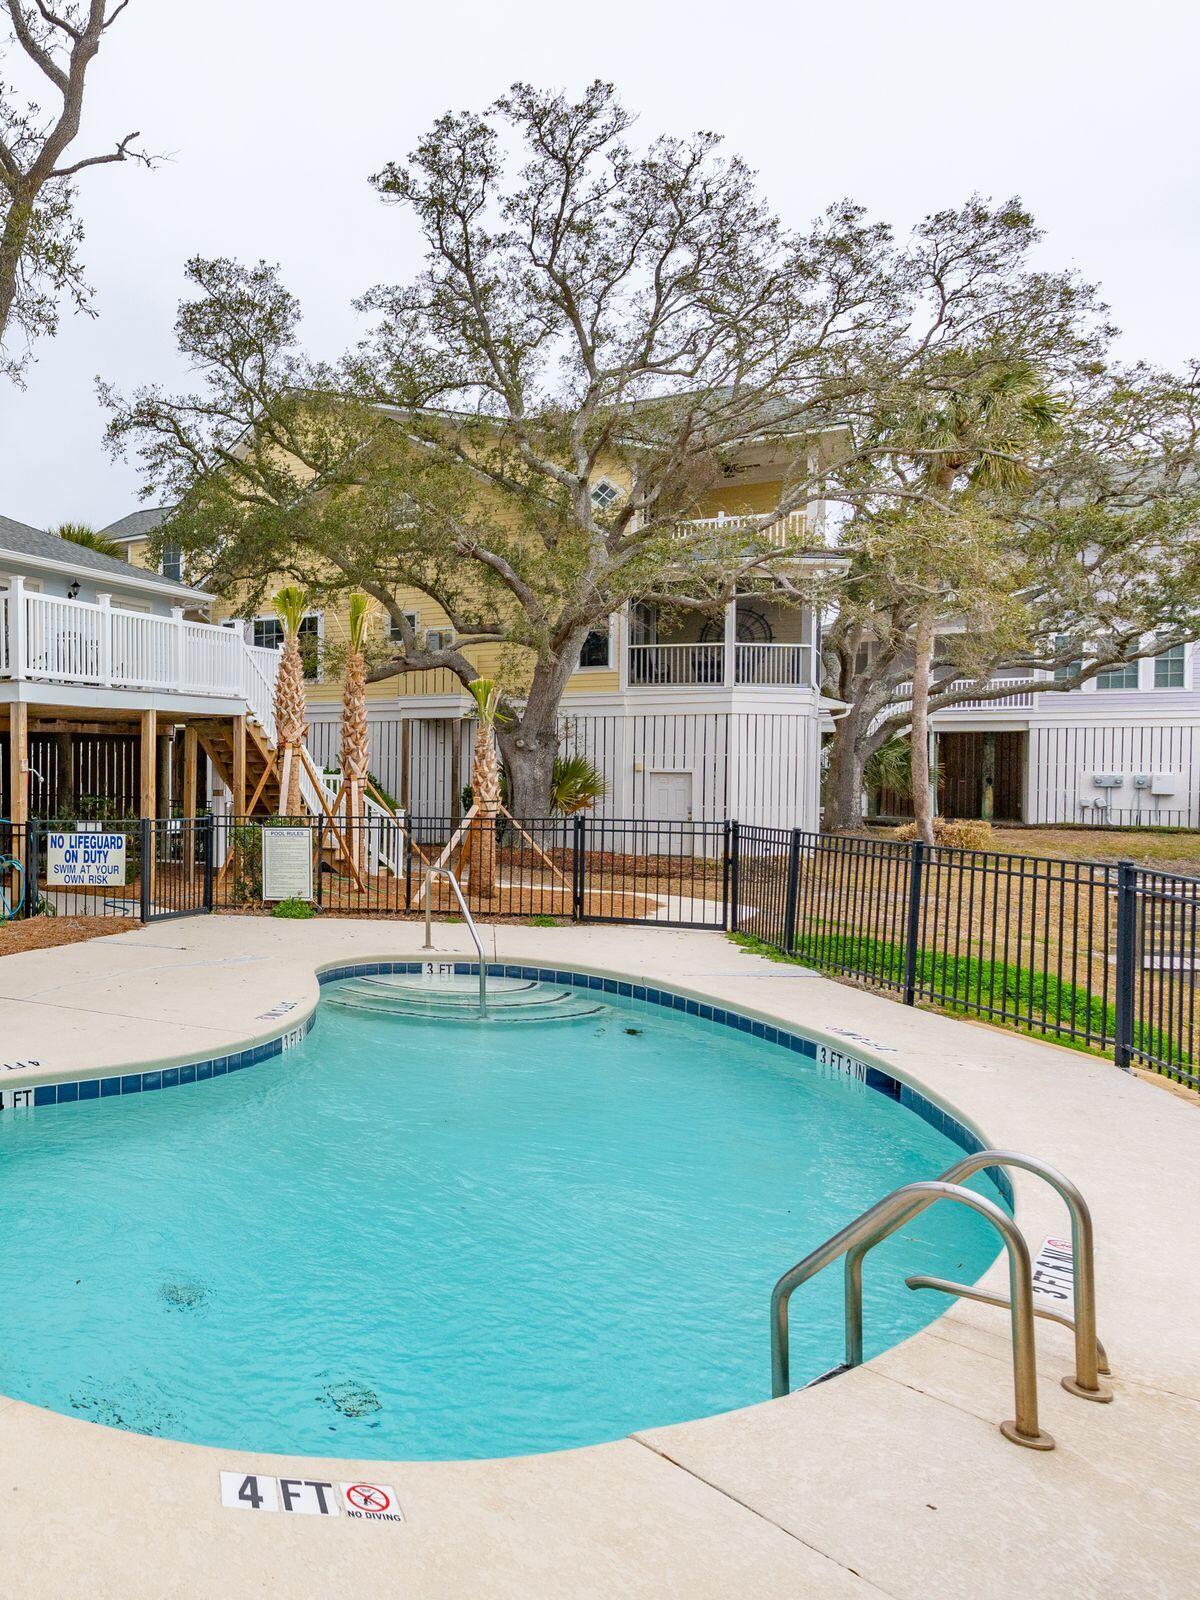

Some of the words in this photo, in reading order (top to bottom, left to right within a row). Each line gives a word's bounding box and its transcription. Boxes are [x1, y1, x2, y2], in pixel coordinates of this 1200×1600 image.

[50, 835, 64, 849] NO
[69, 835, 123, 849] LIFEGUARD
[64, 849, 78, 863] ON
[83, 849, 109, 863] DUTY
[53, 864, 76, 874] SWIM
[80, 864, 91, 874] AT
[95, 865, 120, 875] YOUR
[64, 874, 85, 884] OWN
[88, 874, 108, 884] RISK
[426, 962, 434, 974] 3
[439, 964, 453, 974] FT
[820, 1047, 827, 1064] 3
[830, 1051, 843, 1071] FT
[845, 1058, 852, 1076] 3
[854, 1063, 866, 1083] IN
[13, 1089, 32, 1108] FT
[1032, 1270, 1074, 1291] FT
[238, 1475, 264, 1509] 4
[279, 1479, 333, 1515] FT
[347, 1510, 363, 1519] NO
[365, 1511, 401, 1522] DIVING
